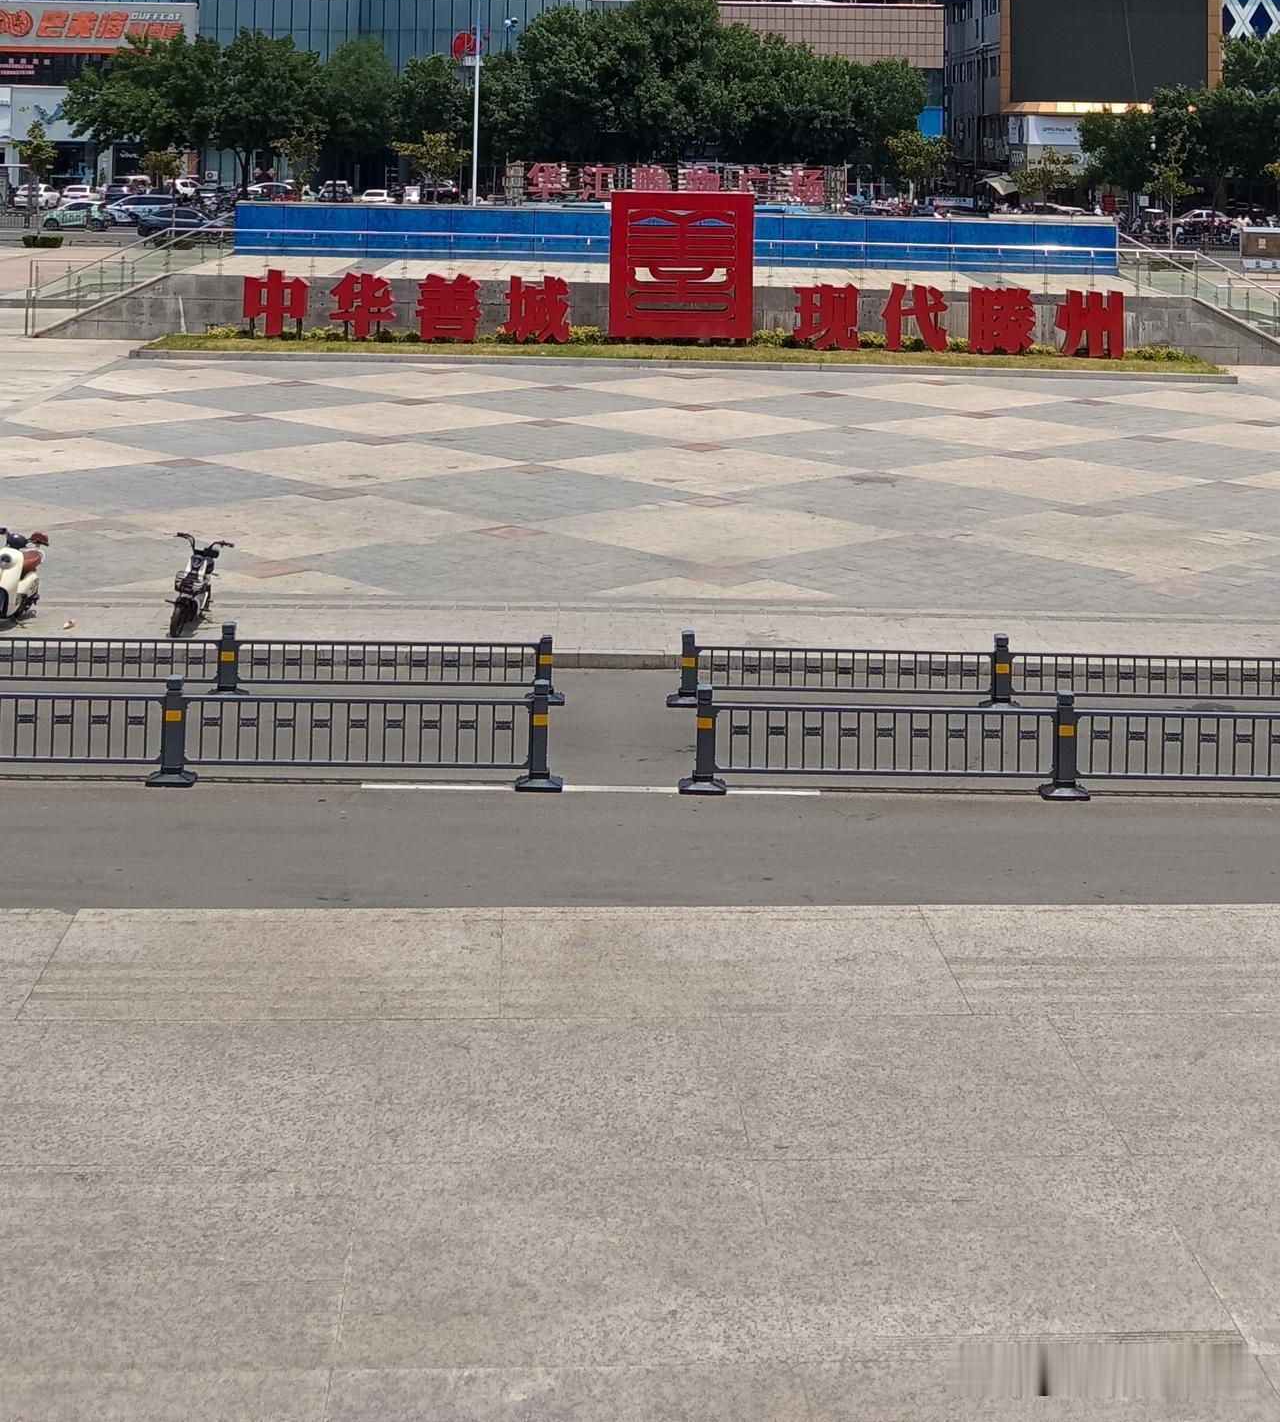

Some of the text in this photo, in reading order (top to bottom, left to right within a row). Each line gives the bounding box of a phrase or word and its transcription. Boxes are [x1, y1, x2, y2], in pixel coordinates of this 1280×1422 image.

[243, 269, 572, 344] 中华善城
[794, 281, 1125, 360] 现代滕州
